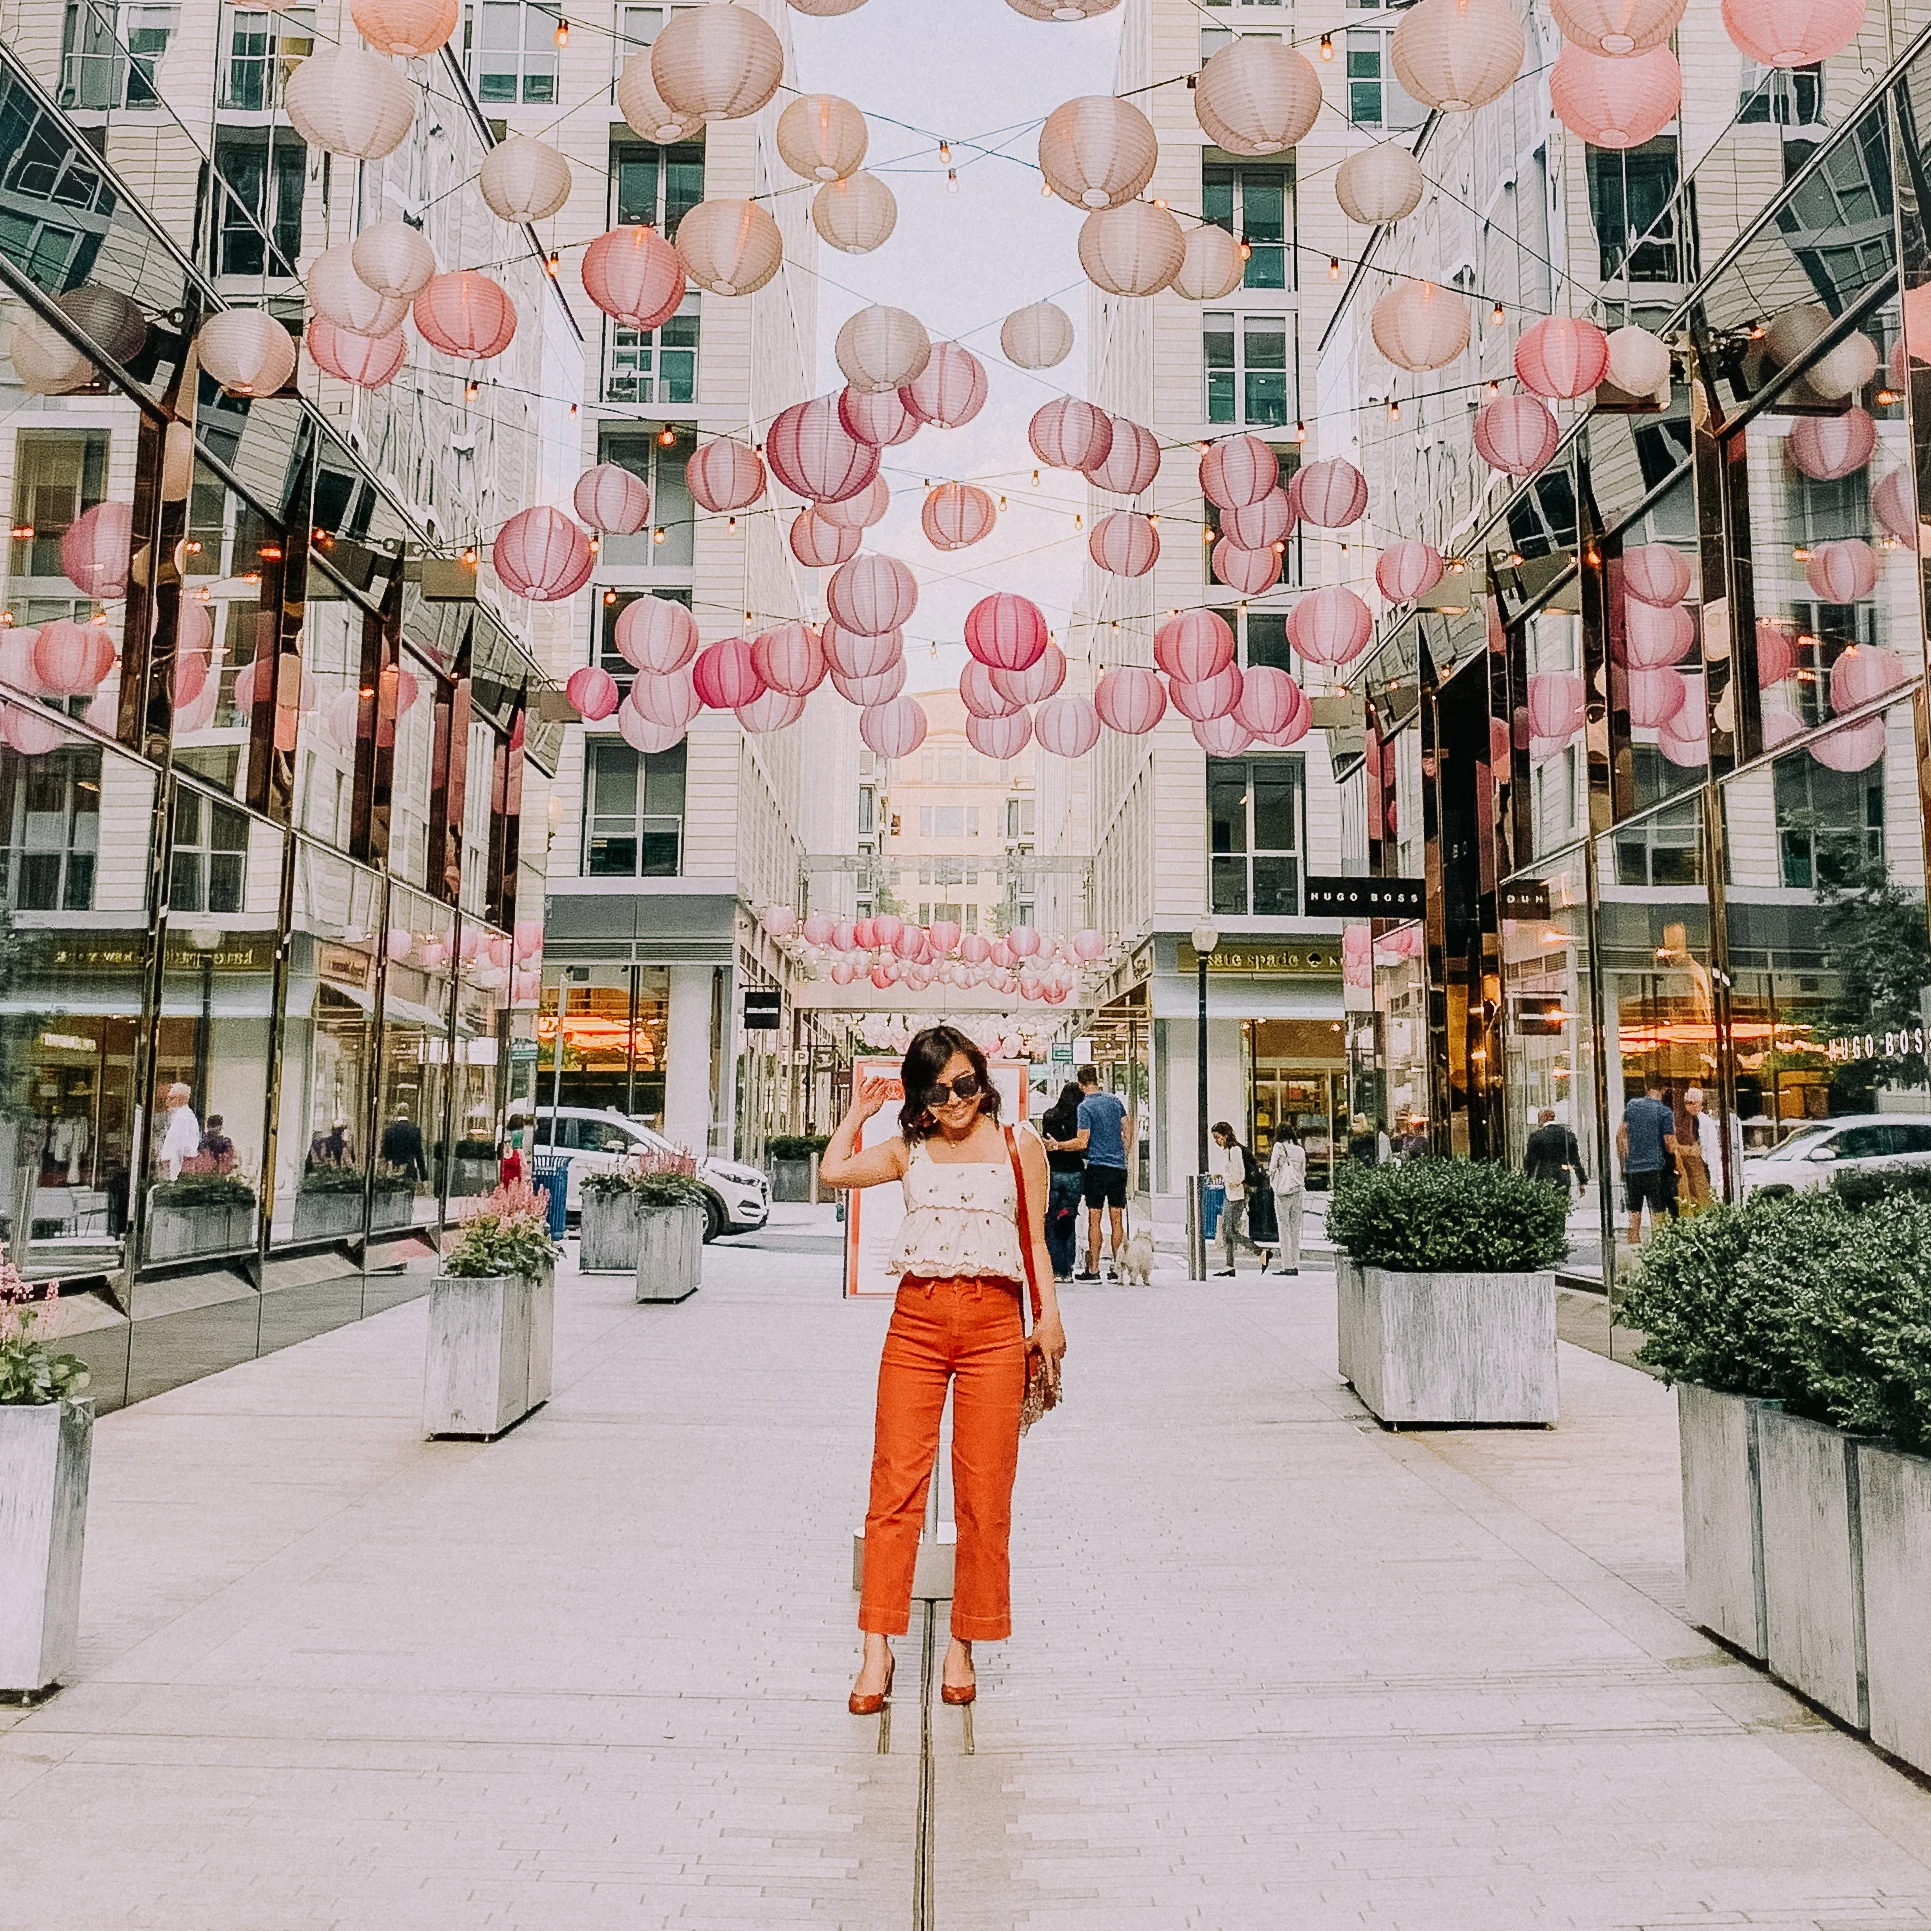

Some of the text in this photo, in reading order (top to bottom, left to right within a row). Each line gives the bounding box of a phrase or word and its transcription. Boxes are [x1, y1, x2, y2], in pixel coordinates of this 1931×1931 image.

[1310, 892, 1418, 903] HUGO BOSS
[1247, 951, 1299, 970] spade
[1828, 1027, 1931, 1061] HUGO BOS
